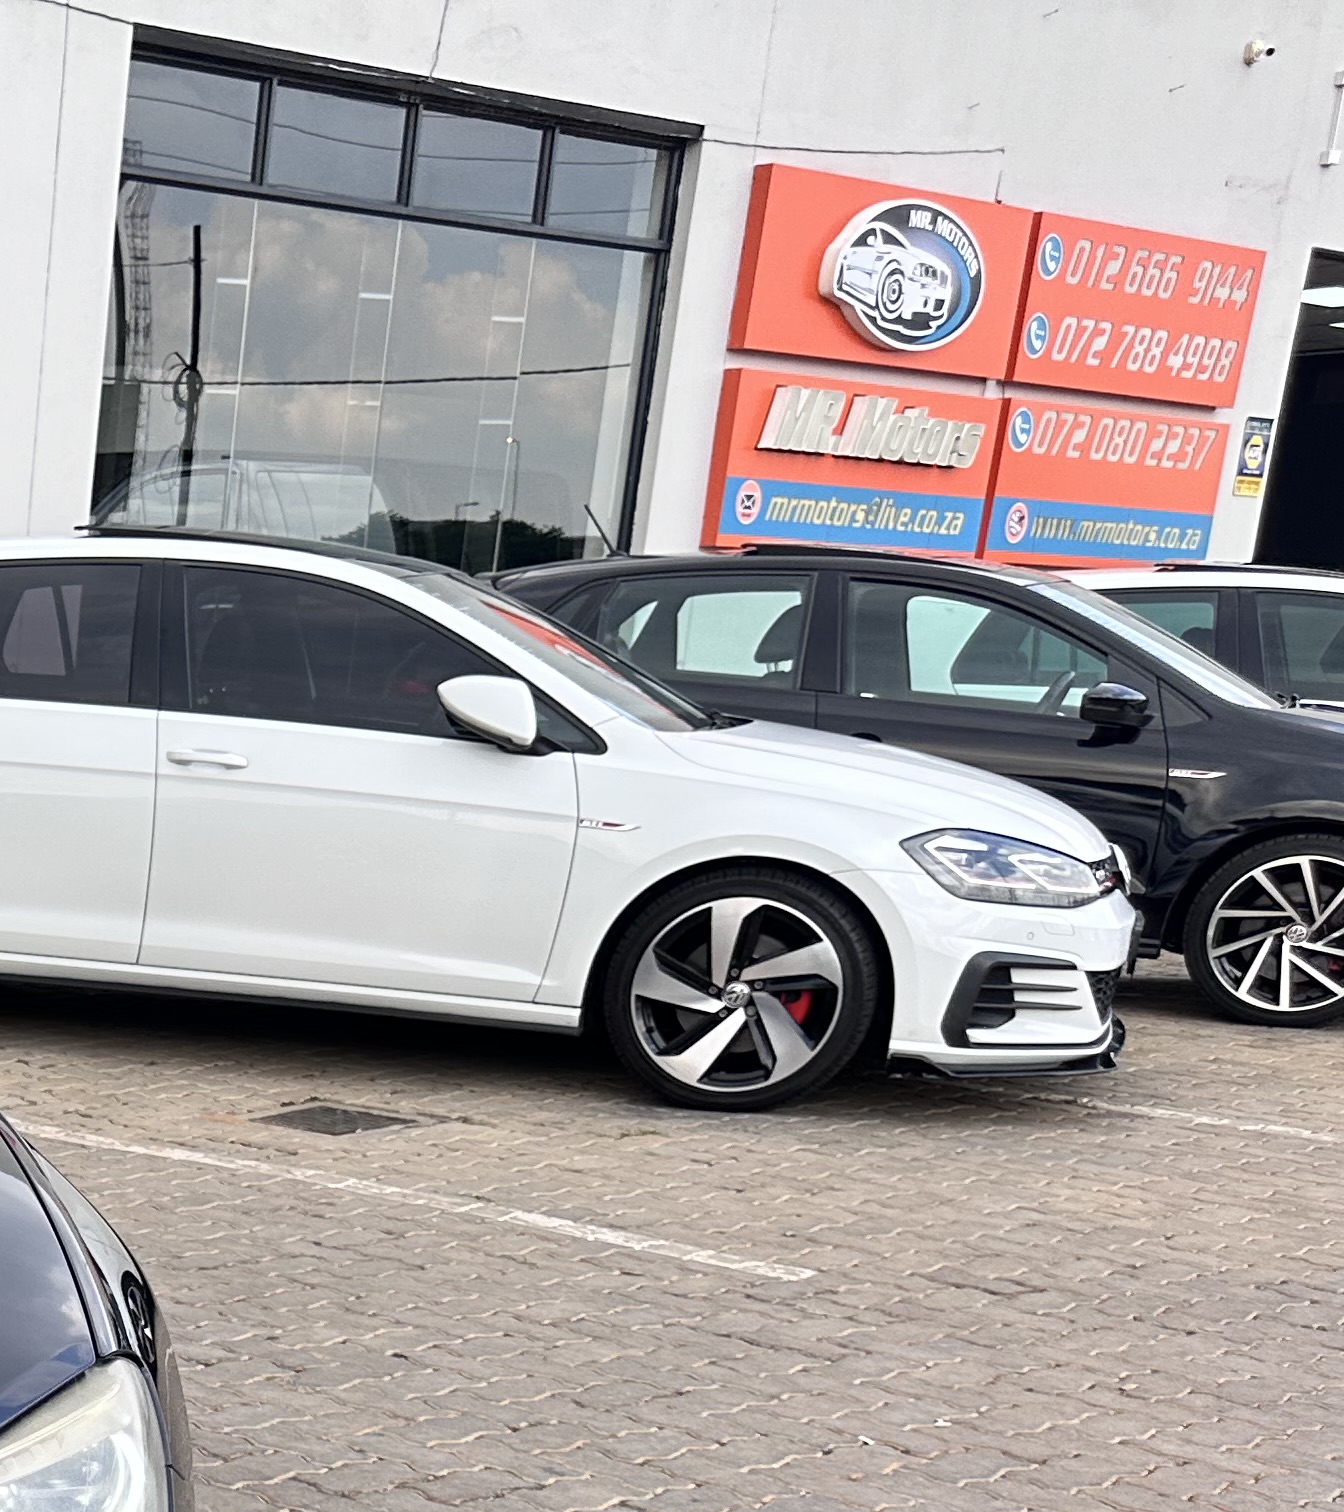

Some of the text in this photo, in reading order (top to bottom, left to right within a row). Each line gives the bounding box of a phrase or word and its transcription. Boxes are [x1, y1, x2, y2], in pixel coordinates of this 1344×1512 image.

[908, 210, 979, 278] MR. MOTORS
[1065, 239, 1254, 311] 012 666 9144
[1051, 316, 1239, 383] 072 788 4998
[757, 385, 985, 468] MR. Motors
[1032, 410, 1218, 470] 072 080 2237
[1030, 517, 1201, 550] www.mrmotors.co.za
